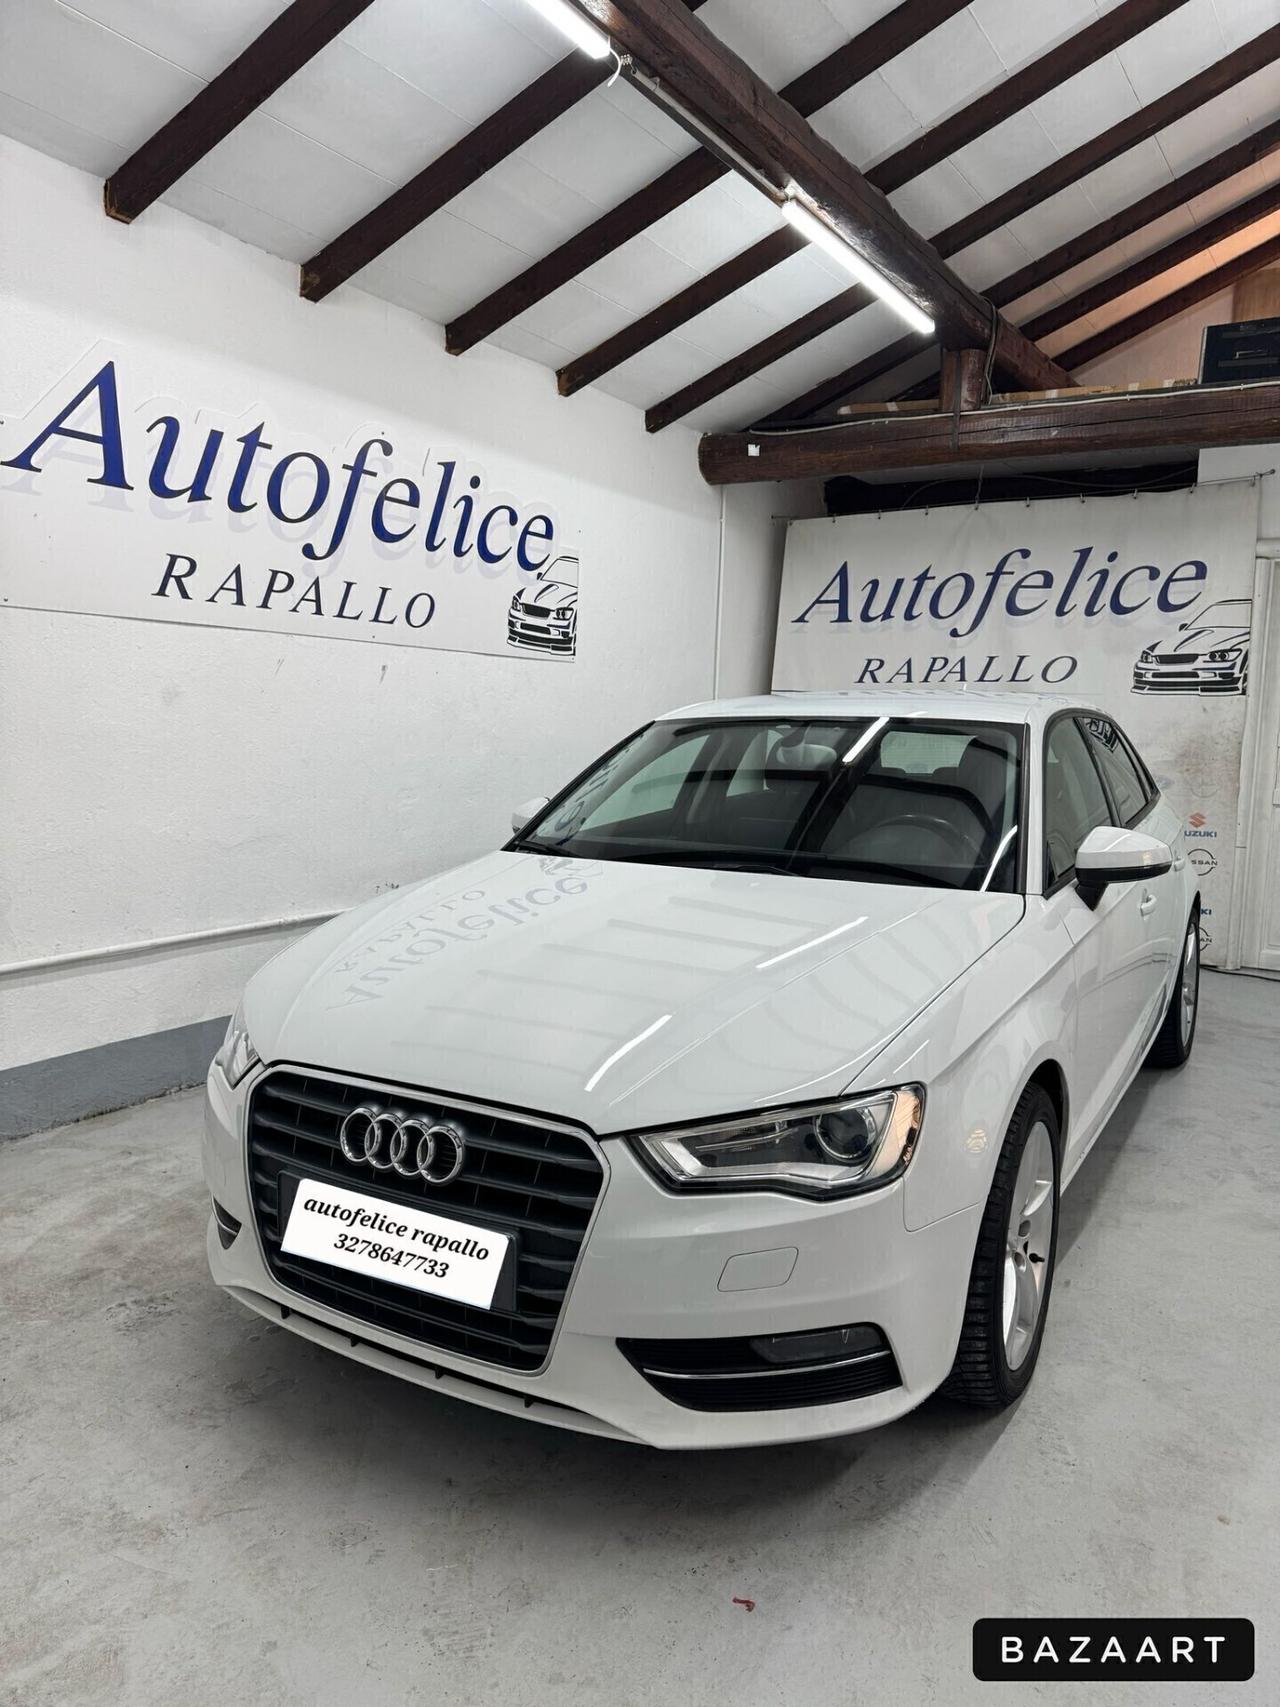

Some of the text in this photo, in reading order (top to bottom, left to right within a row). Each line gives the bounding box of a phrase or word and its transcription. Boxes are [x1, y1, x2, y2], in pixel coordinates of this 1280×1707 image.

[0, 360, 555, 572] Autofelice
[151, 553, 436, 629] RAPALLO
[791, 546, 1208, 638] Autofelice
[854, 655, 1078, 684] RAPALLO
[1184, 830, 1217, 838] UZUKI
